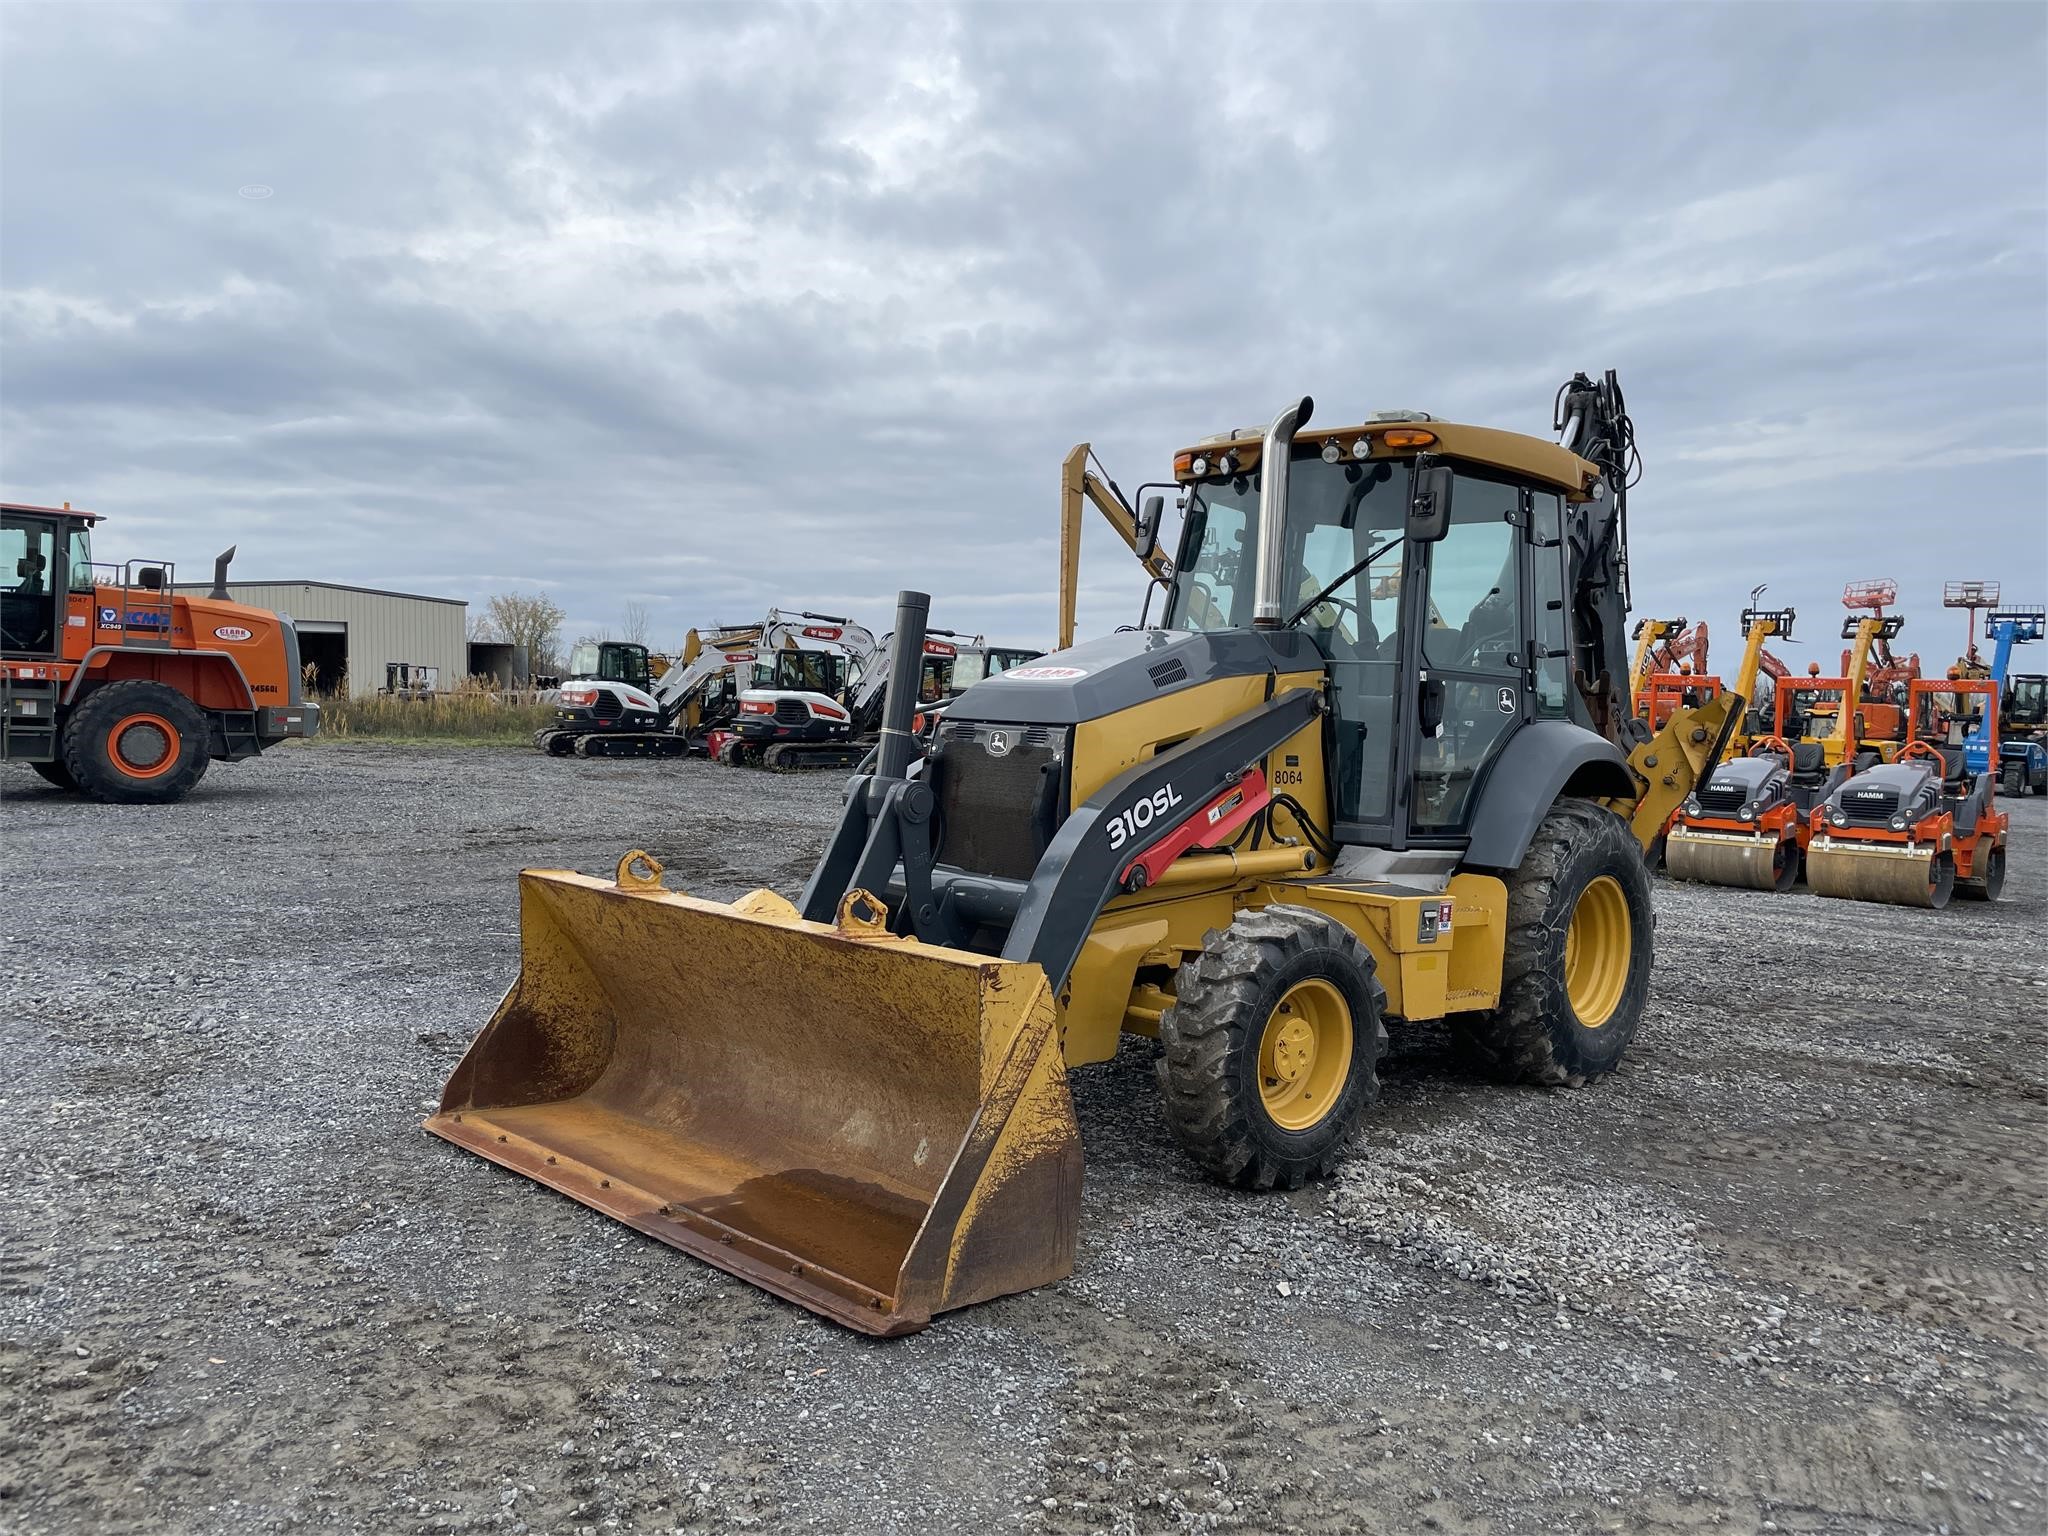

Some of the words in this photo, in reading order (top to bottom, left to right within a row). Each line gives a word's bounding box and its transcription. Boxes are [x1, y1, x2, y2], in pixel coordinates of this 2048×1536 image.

[220, 628, 246, 636] CLARK
[1014, 668, 1080, 677] CLARK
[1275, 770, 1303, 785] 8064
[1710, 785, 1734, 793] HAMM
[1857, 791, 1884, 799] HAMM
[1106, 782, 1183, 850] 310SL
